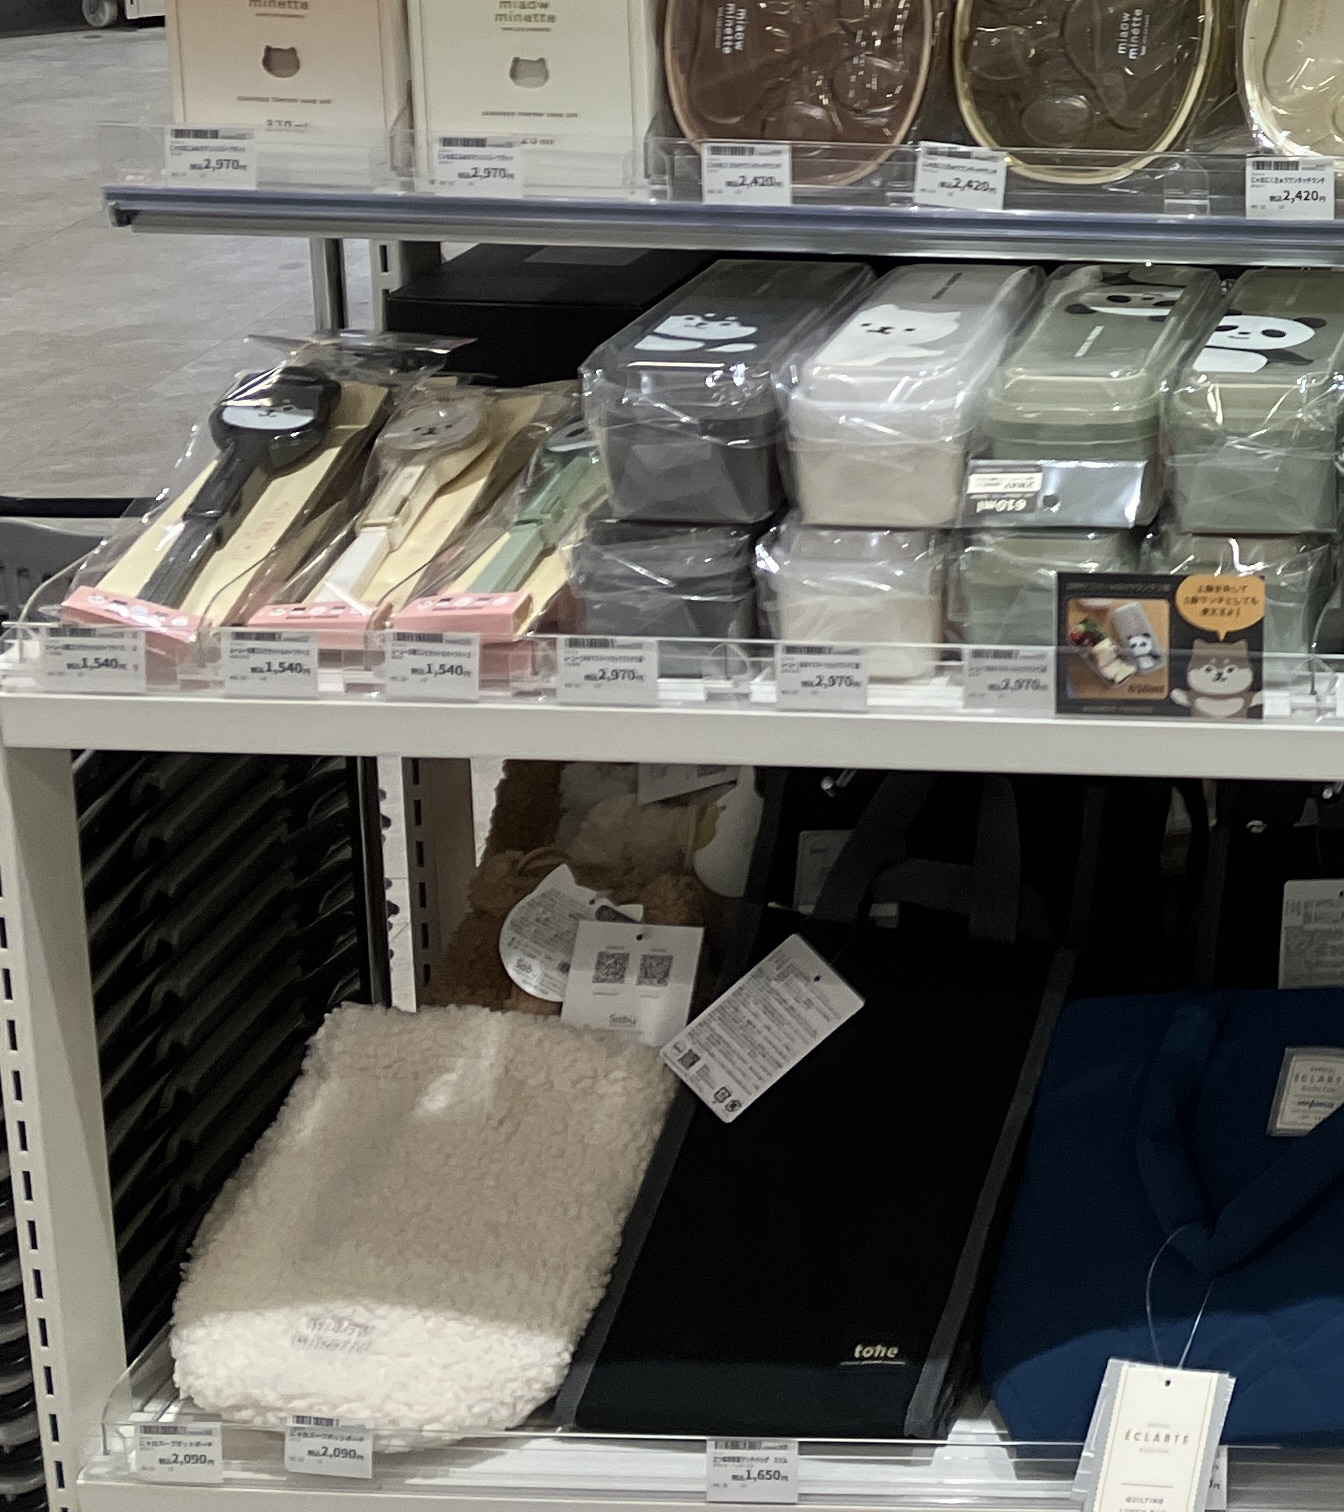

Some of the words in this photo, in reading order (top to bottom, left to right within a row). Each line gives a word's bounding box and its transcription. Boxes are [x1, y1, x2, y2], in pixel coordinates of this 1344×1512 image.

[494, 11, 557, 23] minette
[1268, 188, 1327, 204] 税込2,420円
[1123, 1429, 1191, 1446] ÉCLARTE
